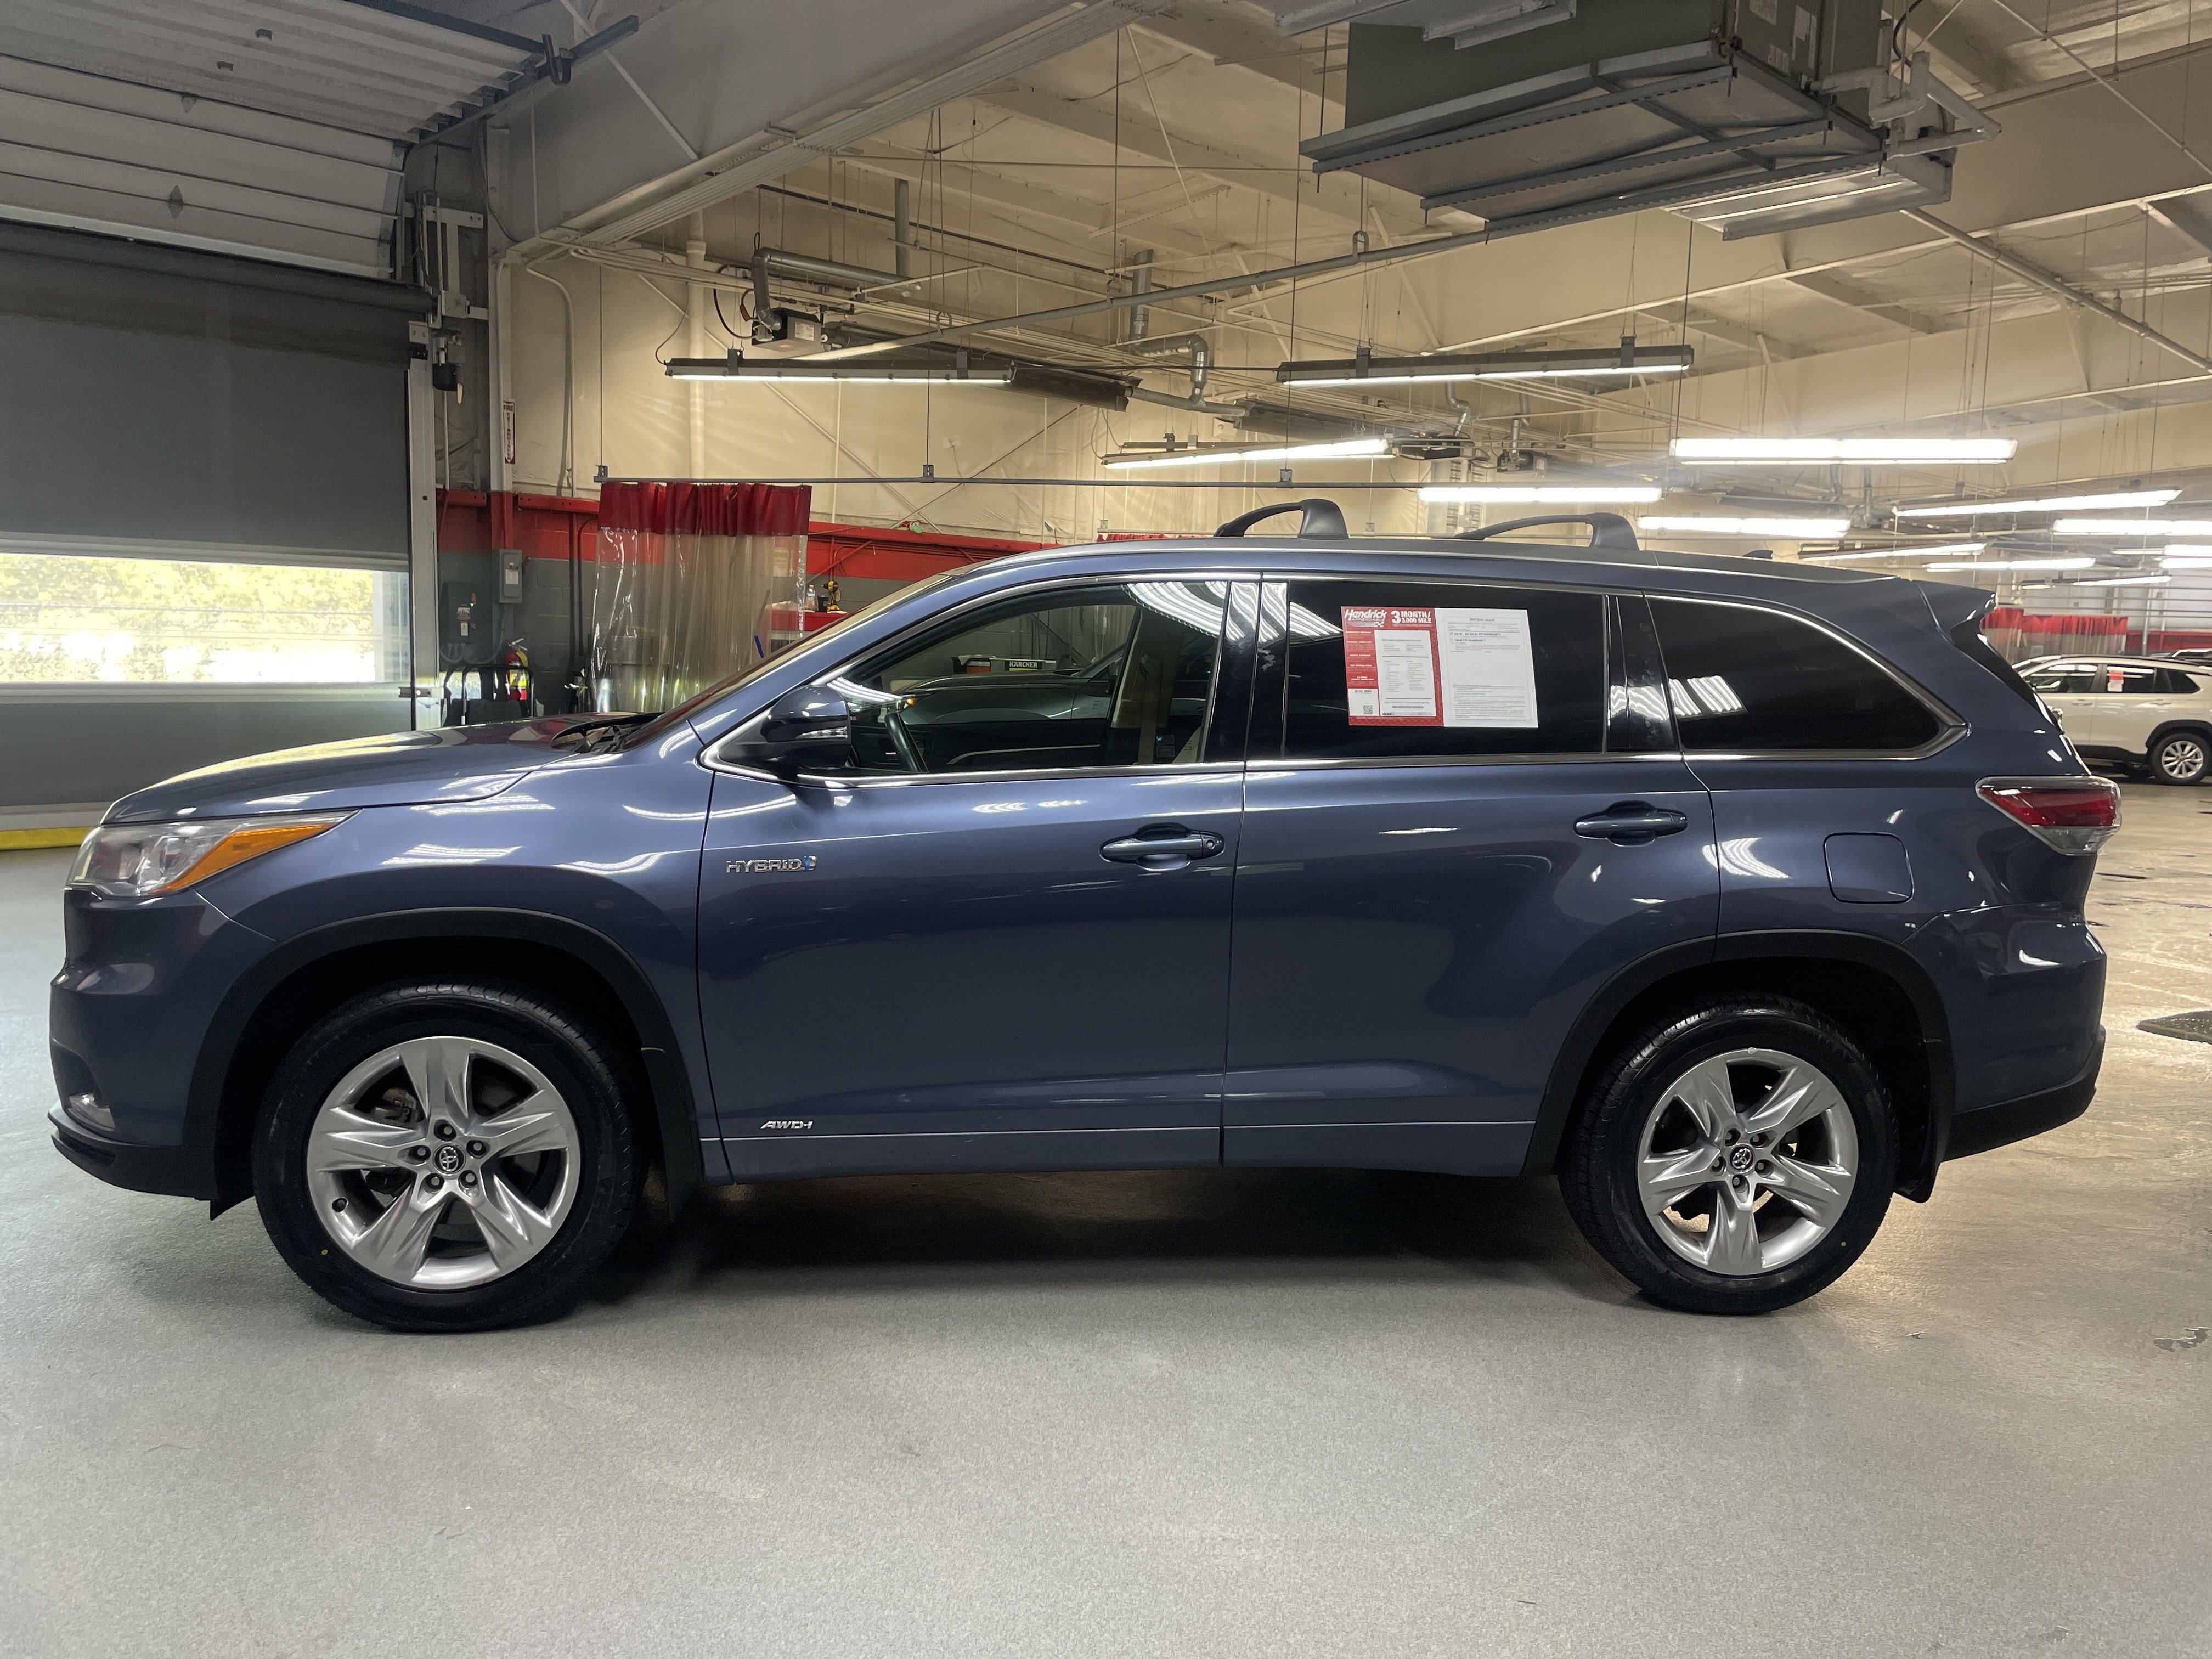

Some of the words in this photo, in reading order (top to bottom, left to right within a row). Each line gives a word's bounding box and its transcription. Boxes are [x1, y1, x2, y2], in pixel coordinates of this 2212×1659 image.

[1344, 608, 1387, 621] Hendrick
[1391, 610, 1401, 624] 3
[726, 859, 803, 873] HYBRID
